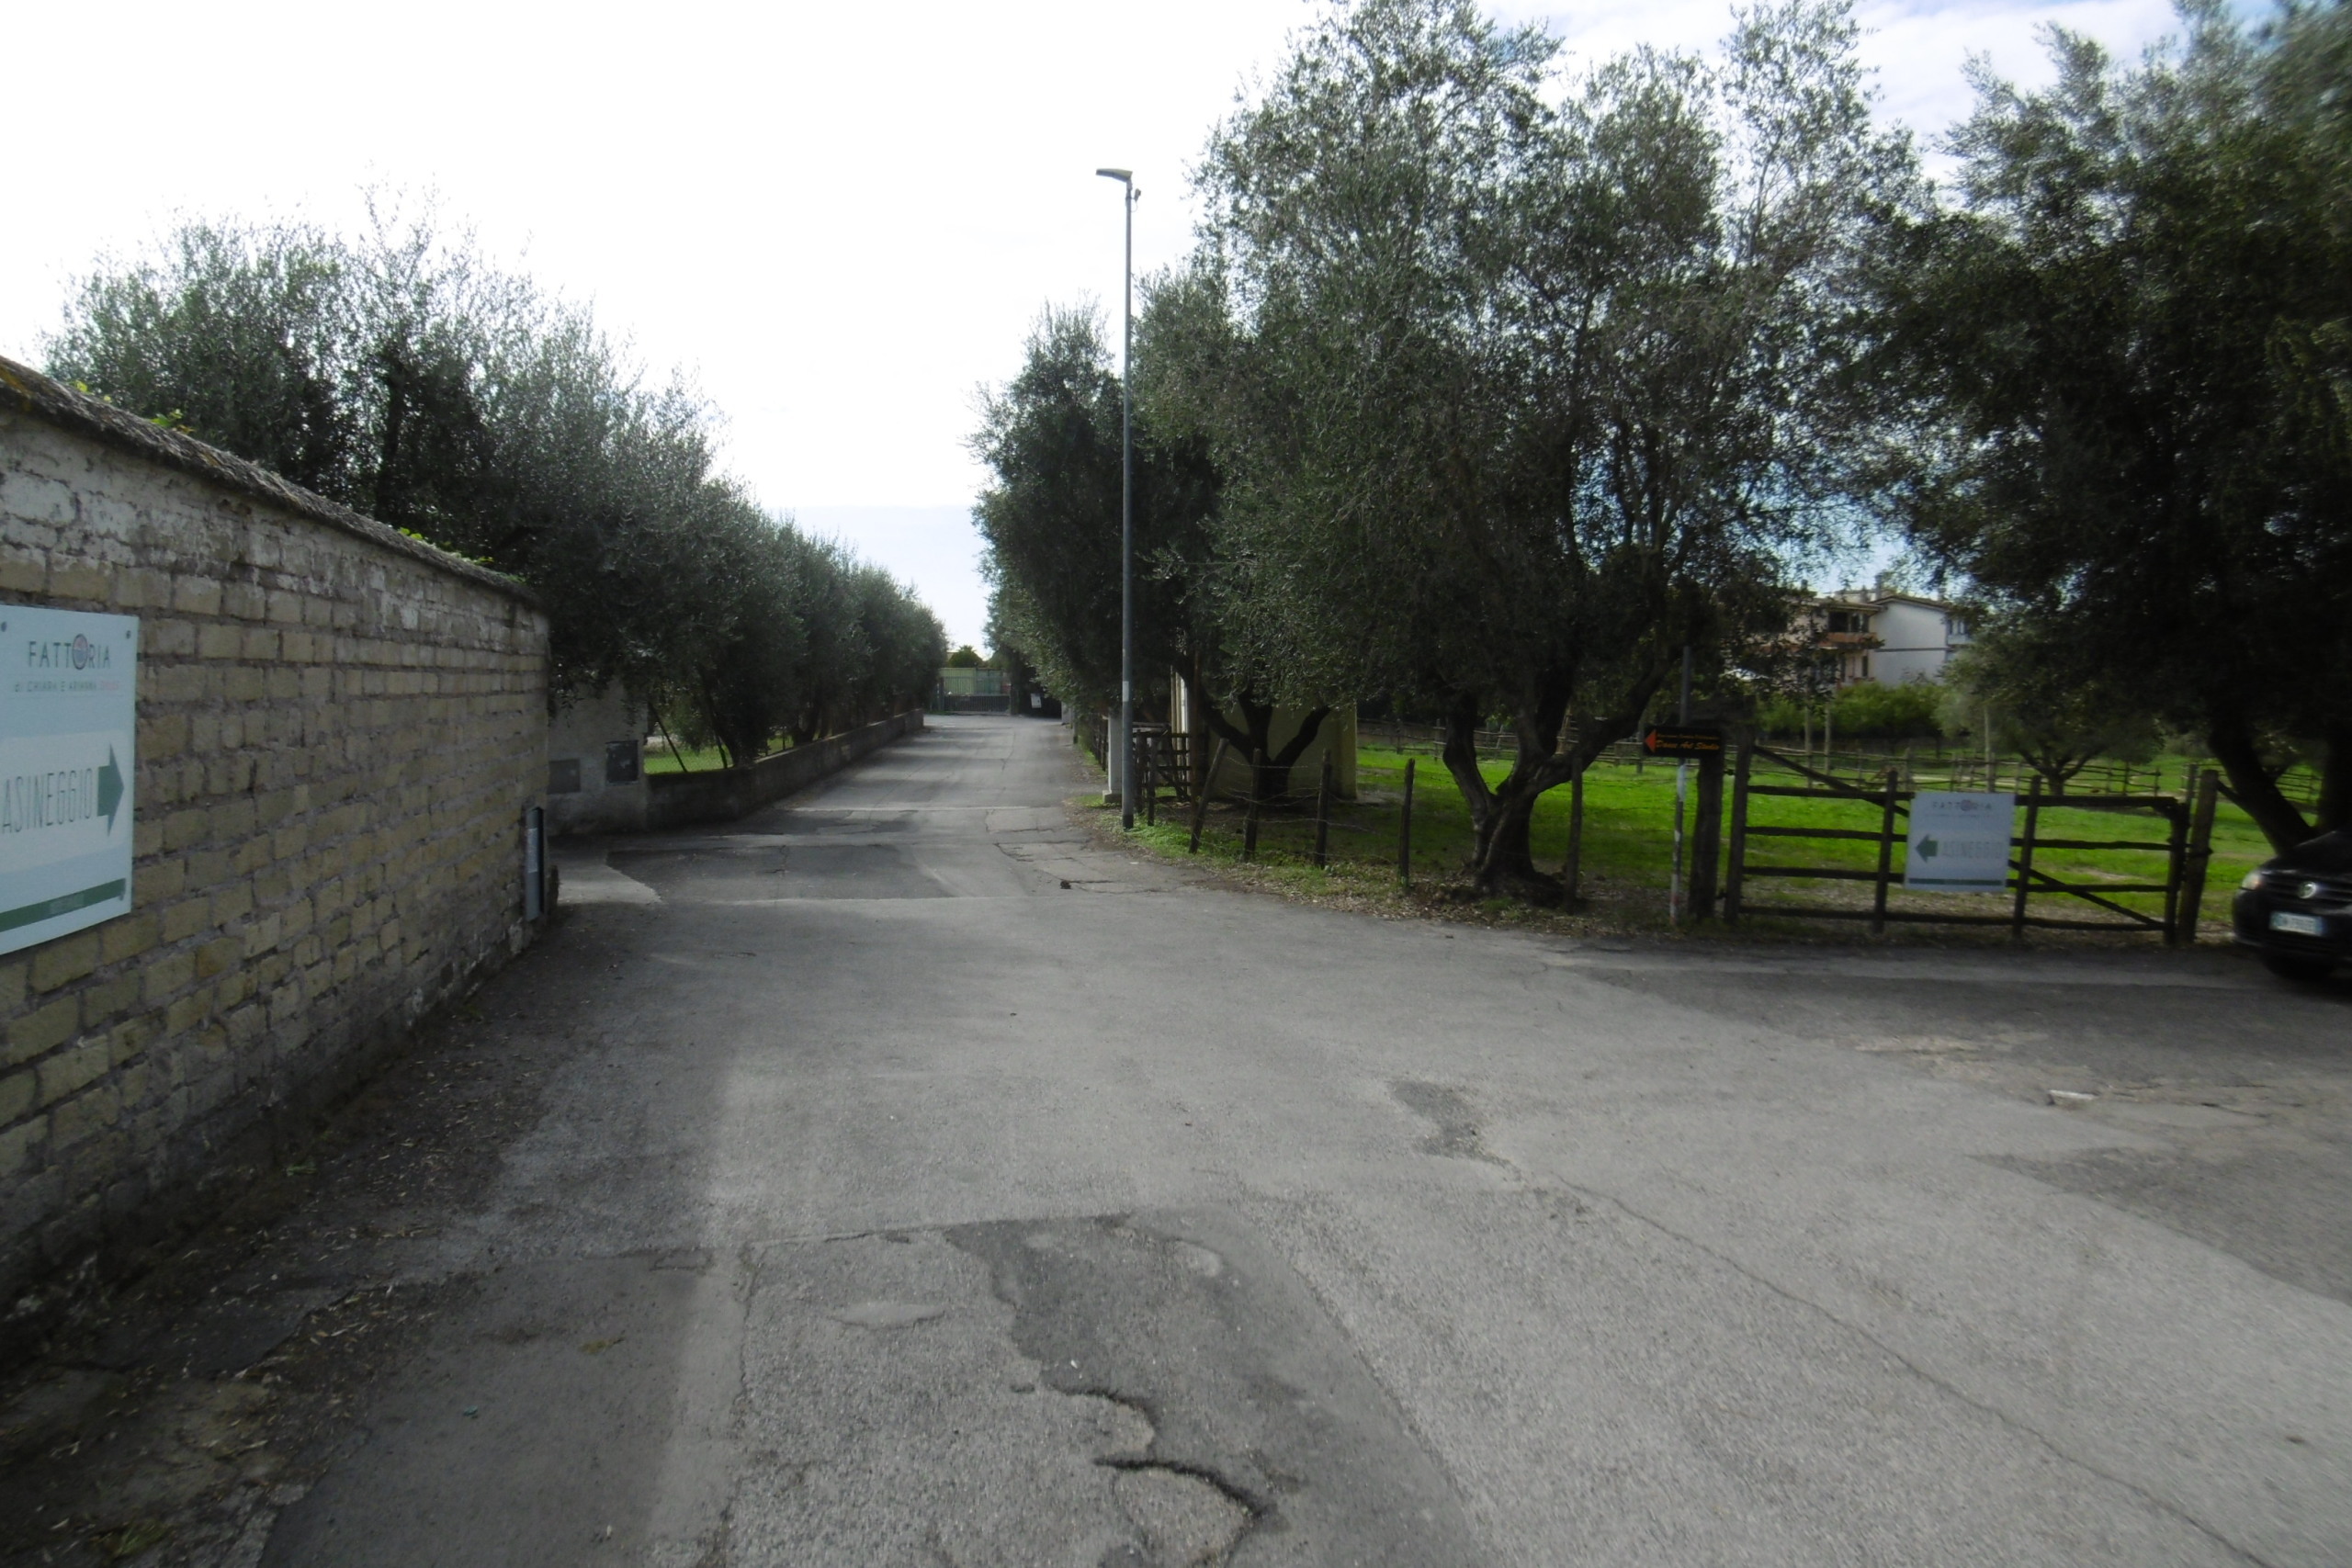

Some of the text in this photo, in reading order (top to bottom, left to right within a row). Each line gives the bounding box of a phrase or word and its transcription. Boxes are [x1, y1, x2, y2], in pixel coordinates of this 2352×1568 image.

[28, 633, 111, 671] FATTORIA
[2, 768, 94, 834] ASINEGGIO
[1932, 799, 1992, 811] FATTORIA
